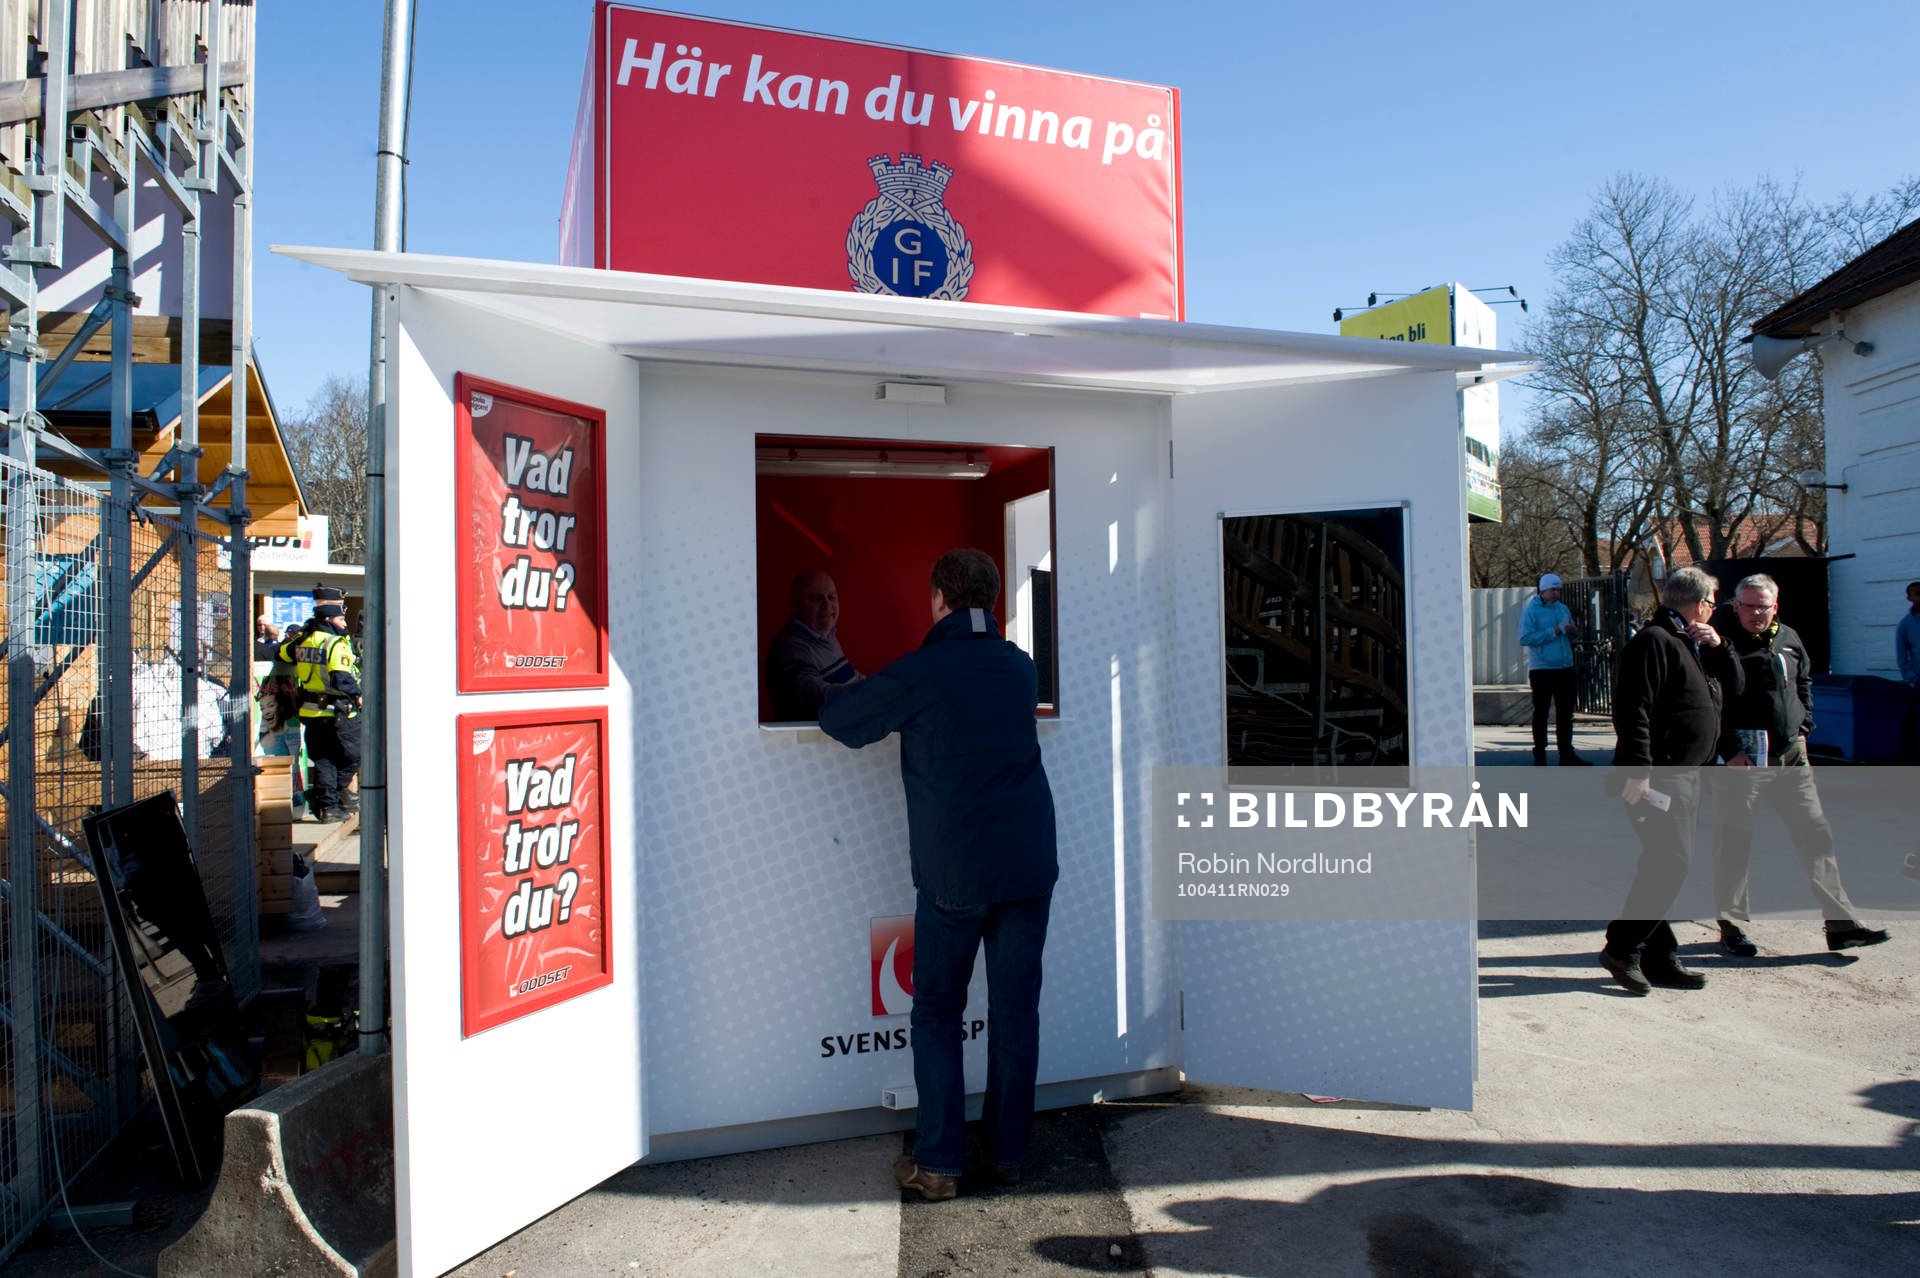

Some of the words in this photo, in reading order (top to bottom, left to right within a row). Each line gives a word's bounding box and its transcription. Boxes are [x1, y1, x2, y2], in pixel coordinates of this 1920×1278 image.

[617, 38, 732, 97] Här
[743, 54, 849, 115] kan
[864, 74, 934, 126] du
[948, 90, 1092, 149] vinna
[1101, 114, 1166, 165] på
[894, 228, 921, 255] G
[504, 435, 574, 496] Vad
[501, 495, 576, 552] tror
[500, 557, 576, 610] du?
[514, 655, 568, 668] ODDSET
[506, 756, 576, 813] Vad
[503, 821, 579, 873] tror
[503, 870, 579, 937] du?
[518, 966, 572, 994] ODDSET
[821, 1028, 913, 1058] SVENS
